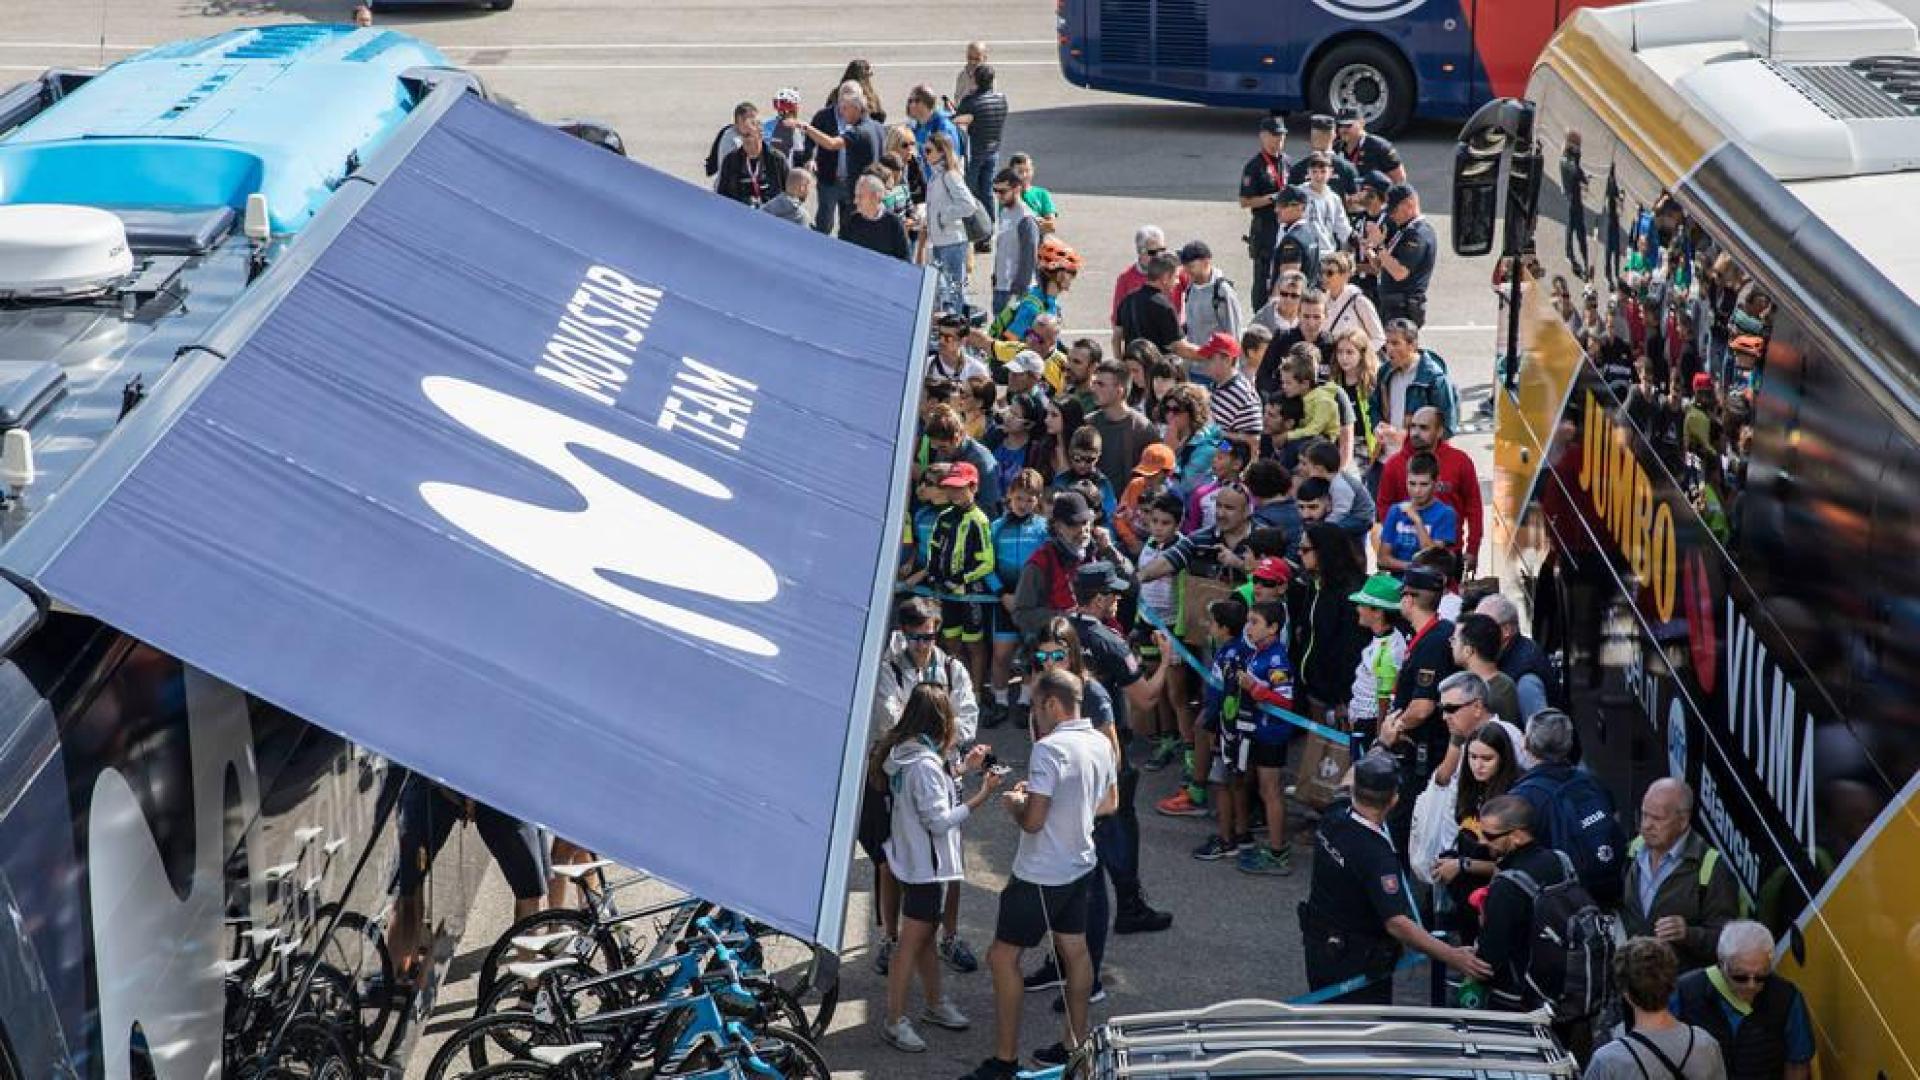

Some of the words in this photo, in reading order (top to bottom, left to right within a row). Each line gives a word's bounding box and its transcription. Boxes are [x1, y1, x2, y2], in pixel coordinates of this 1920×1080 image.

[534, 264, 664, 406] MOVISTAR
[657, 356, 758, 451] TEAM
[1579, 387, 1677, 624] JUMBO
[1700, 762, 1760, 897] Bianchi
